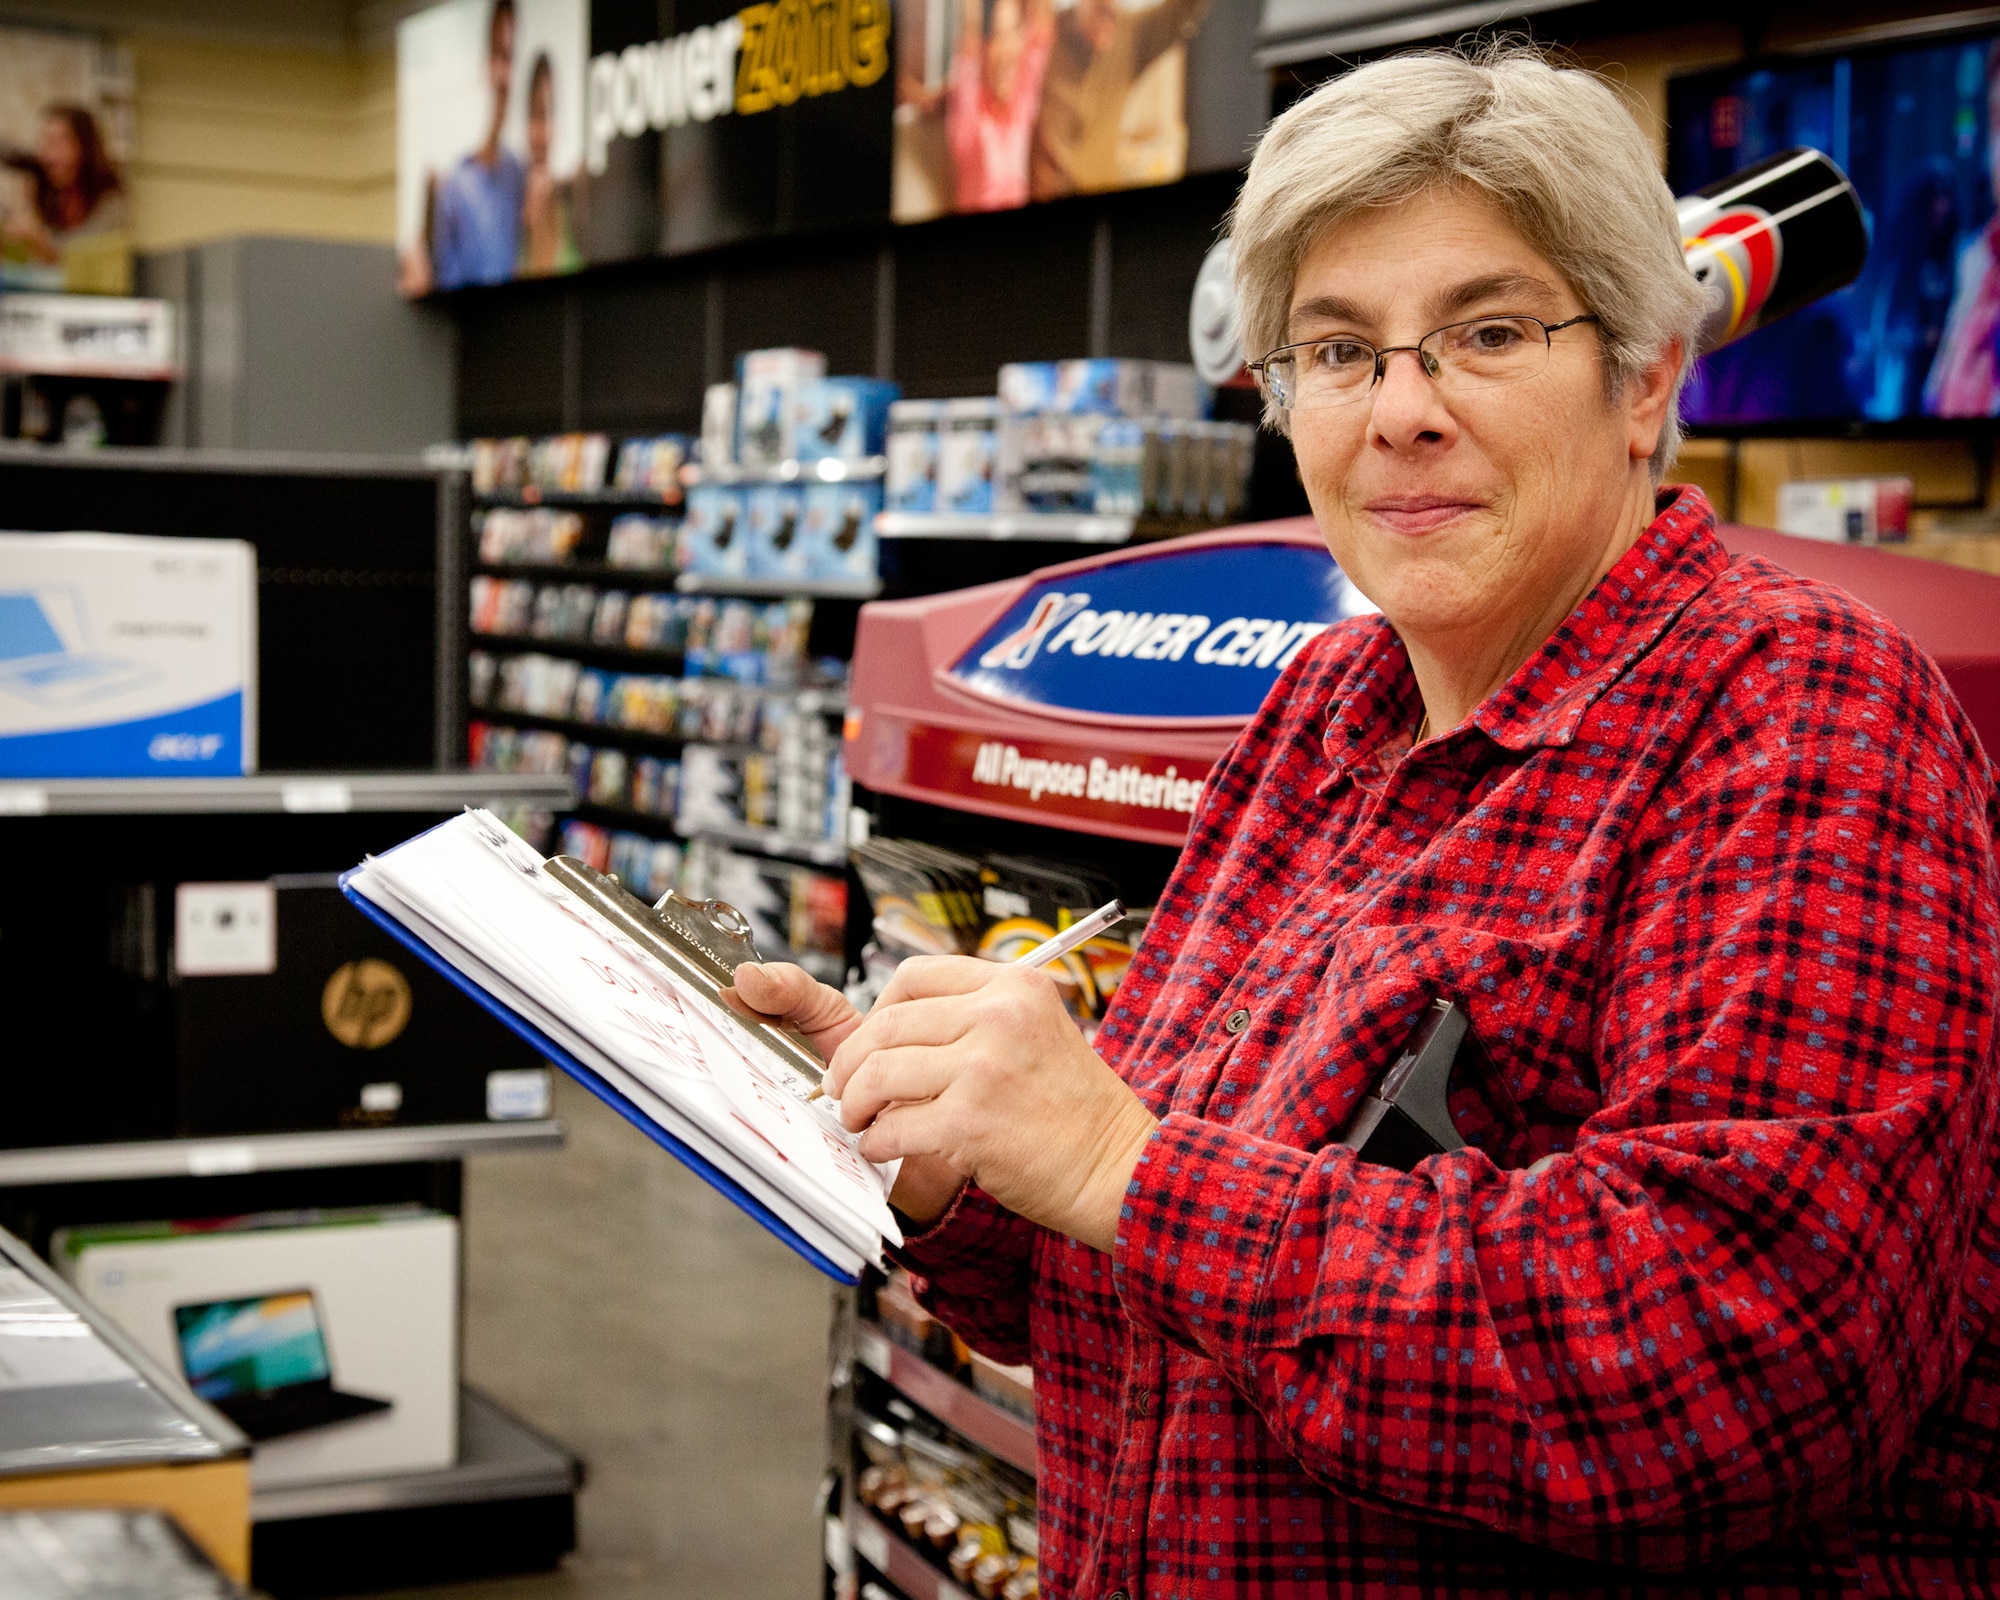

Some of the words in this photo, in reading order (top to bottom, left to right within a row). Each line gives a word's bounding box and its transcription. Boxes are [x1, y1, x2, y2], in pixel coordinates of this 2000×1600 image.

[1046, 609, 1211, 662] POWER
[972, 742, 1003, 784] All
[1001, 745, 1087, 801] Purpose
[1086, 757, 1204, 814] Batteries
[629, 975, 684, 1015] NO
